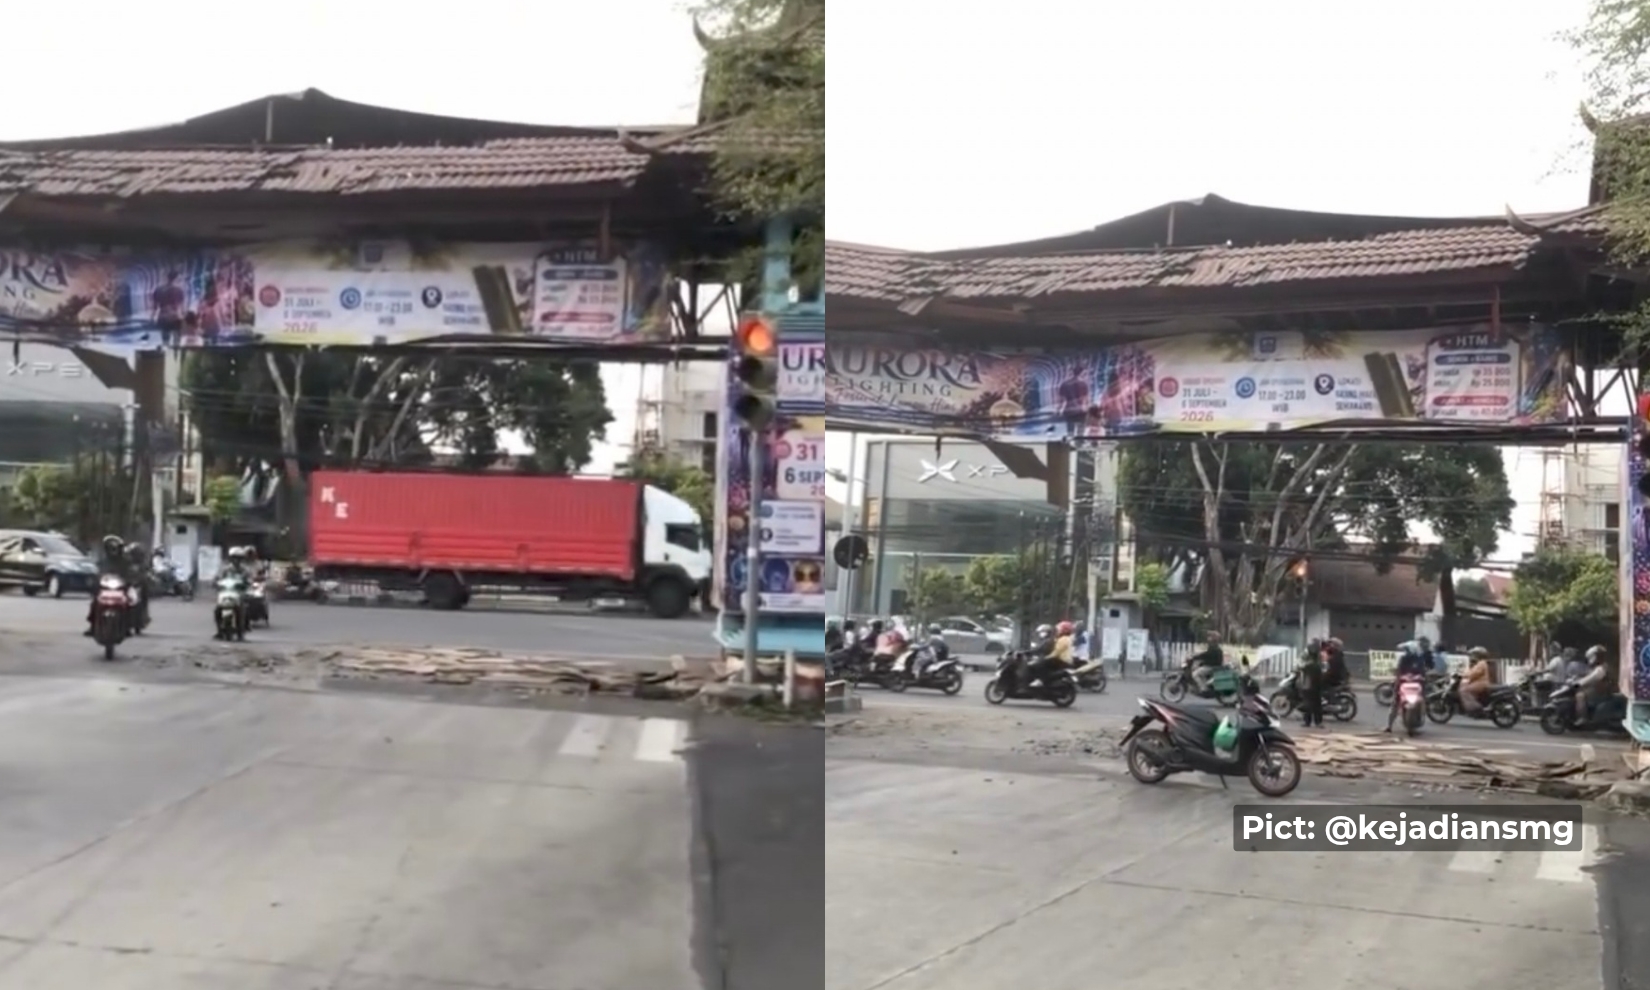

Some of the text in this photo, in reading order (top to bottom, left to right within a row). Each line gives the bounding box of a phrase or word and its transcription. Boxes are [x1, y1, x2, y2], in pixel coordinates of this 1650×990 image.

[1456, 335, 1488, 347] HTM
[1193, 388, 1211, 398] JULI
[1180, 411, 1214, 422] 2026
[796, 443, 817, 461] 31
[785, 467, 795, 483] 6
[321, 487, 335, 502] K
[336, 502, 348, 518] E
[1371, 652, 1397, 660] SEWA
